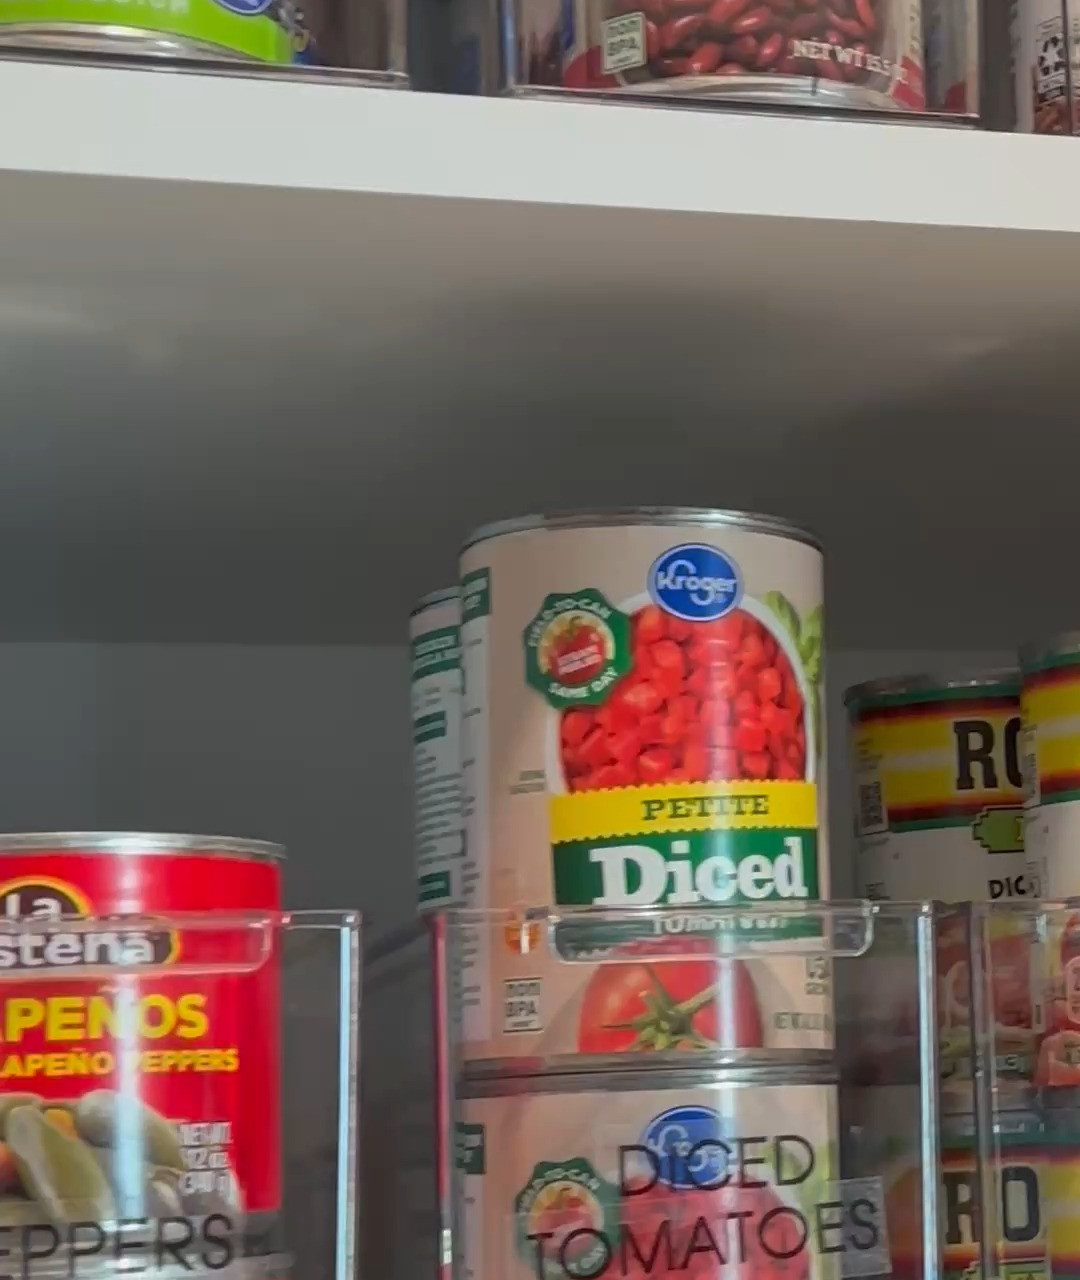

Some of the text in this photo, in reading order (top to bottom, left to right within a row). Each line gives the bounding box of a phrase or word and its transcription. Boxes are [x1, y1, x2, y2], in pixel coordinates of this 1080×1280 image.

[654, 558, 738, 607] Kroger
[641, 794, 771, 822] PETITE
[589, 836, 809, 907] Diced
[618, 1133, 818, 1199] DICED
